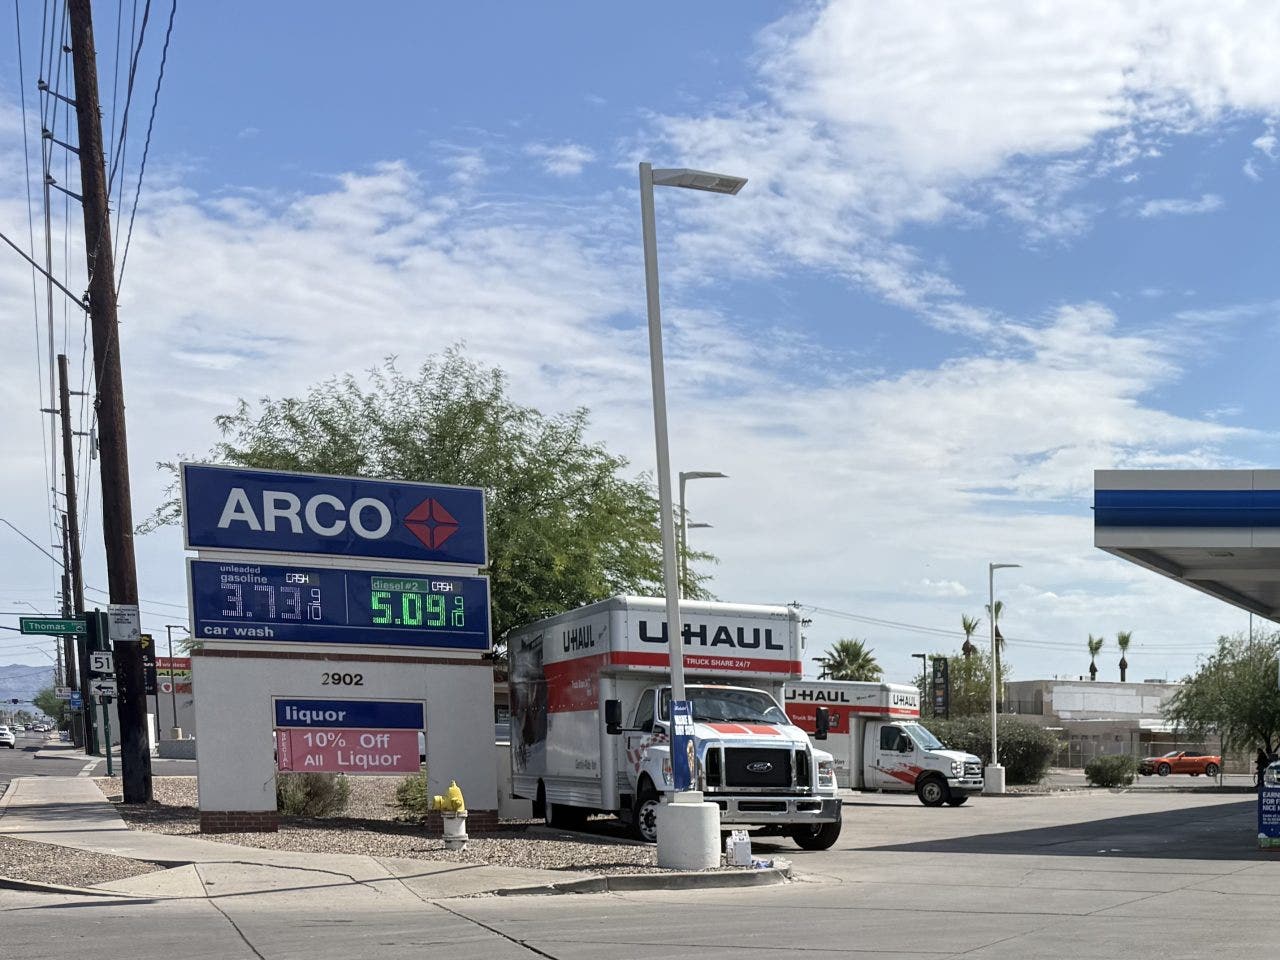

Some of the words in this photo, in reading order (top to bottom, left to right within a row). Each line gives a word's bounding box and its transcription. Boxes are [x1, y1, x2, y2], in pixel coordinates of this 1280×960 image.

[217, 487, 392, 540] ARCO
[220, 566, 260, 574] unleaded
[220, 574, 268, 584] gasoline
[285, 573, 309, 584] CASH
[373, 580, 404, 590] diesel
[431, 581, 453, 592] CASH
[220, 583, 302, 619] 3.73
[371, 591, 446, 626] 5.09
[29, 622, 66, 631] Thomas
[203, 626, 229, 635] car
[234, 628, 274, 637] wash
[563, 625, 595, 652] U-HAUL
[94, 656, 110, 670] 51
[686, 657, 710, 666] TRUCK
[711, 659, 734, 667] SHARE
[735, 660, 751, 668] 24/7
[321, 672, 364, 686] 2902
[785, 689, 850, 703] U-HAUL
[893, 694, 917, 707] U-HAUL
[285, 706, 346, 724] liquor
[303, 731, 346, 748] 10%
[360, 733, 390, 749] Off
[304, 754, 323, 766] All
[338, 750, 401, 769] Liquor
